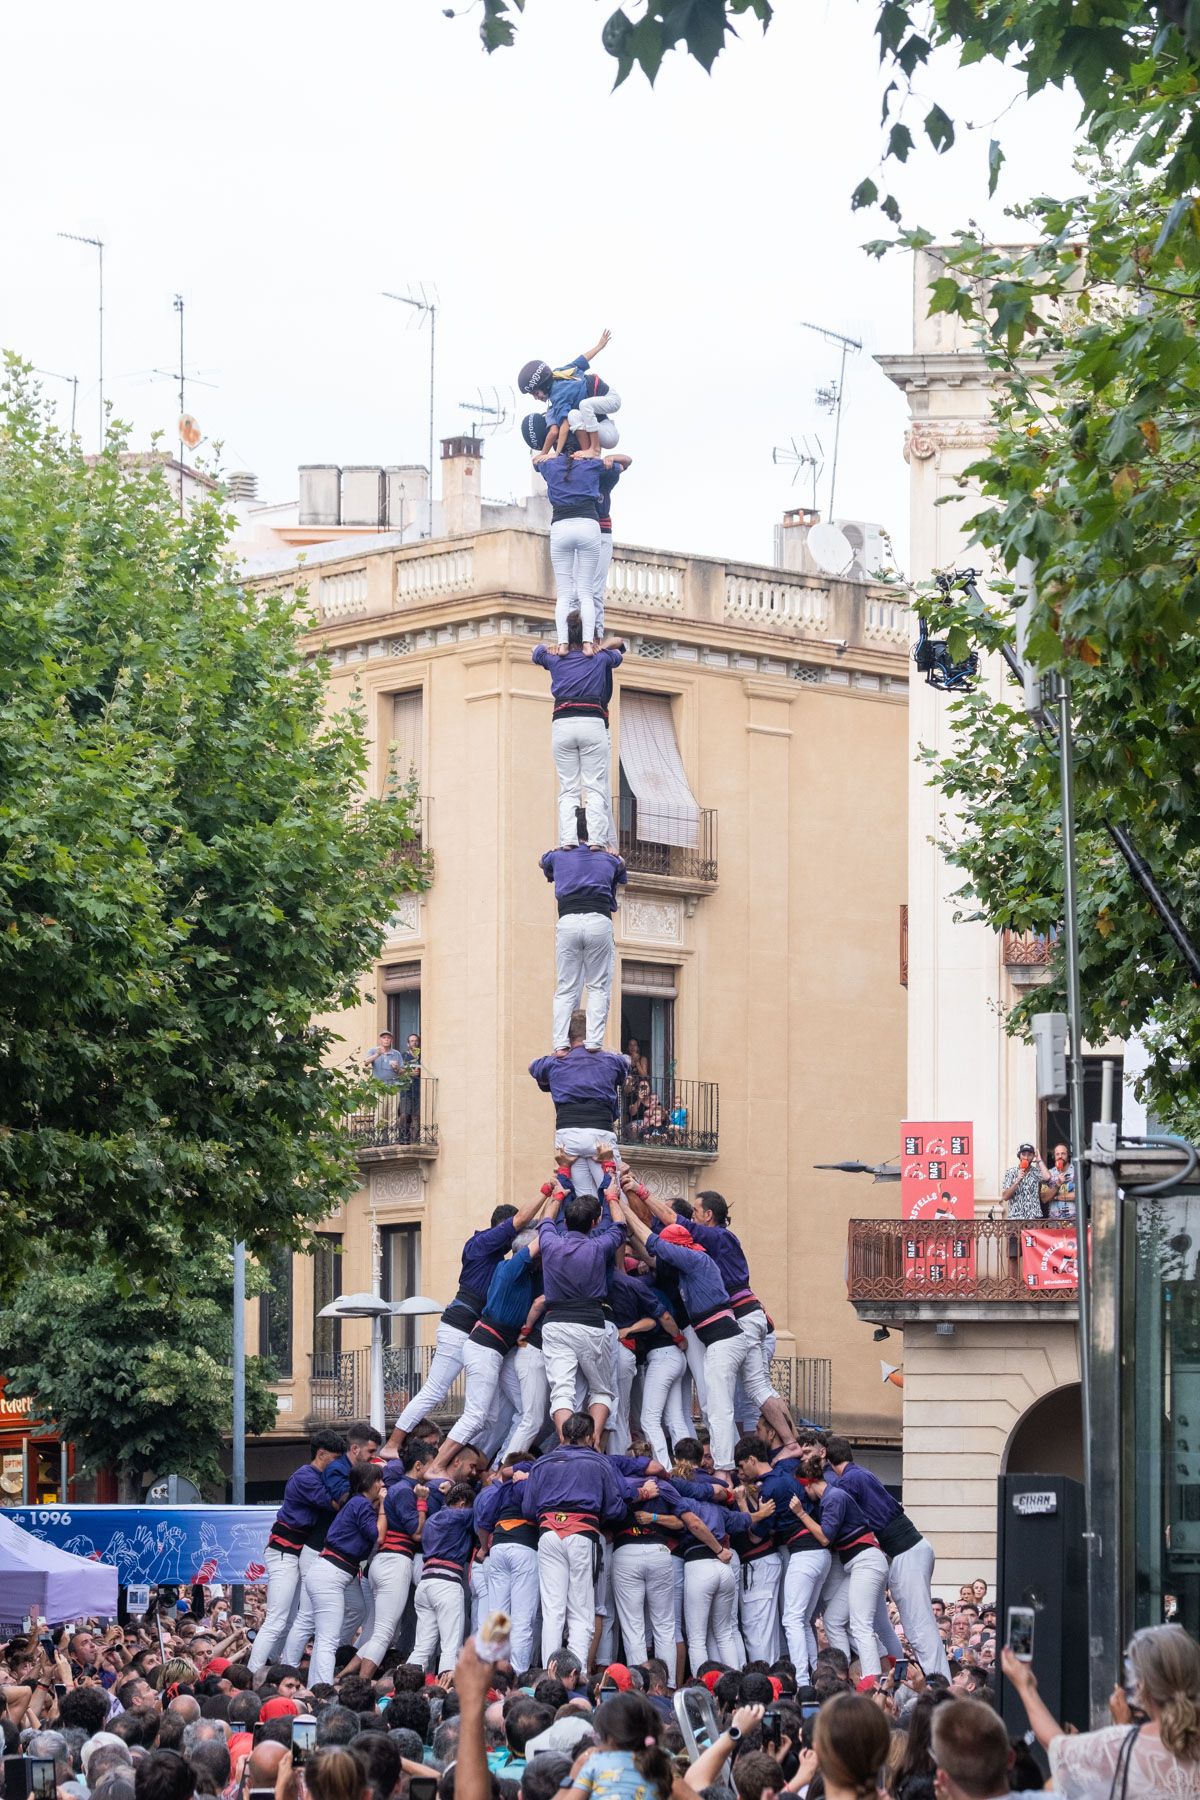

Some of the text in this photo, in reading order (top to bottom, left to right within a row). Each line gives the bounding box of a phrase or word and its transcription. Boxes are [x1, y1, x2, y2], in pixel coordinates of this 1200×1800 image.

[1041, 1241, 1064, 1271] CASTELLS
[12, 1513, 26, 1523] de
[30, 1511, 72, 1526] 1996
